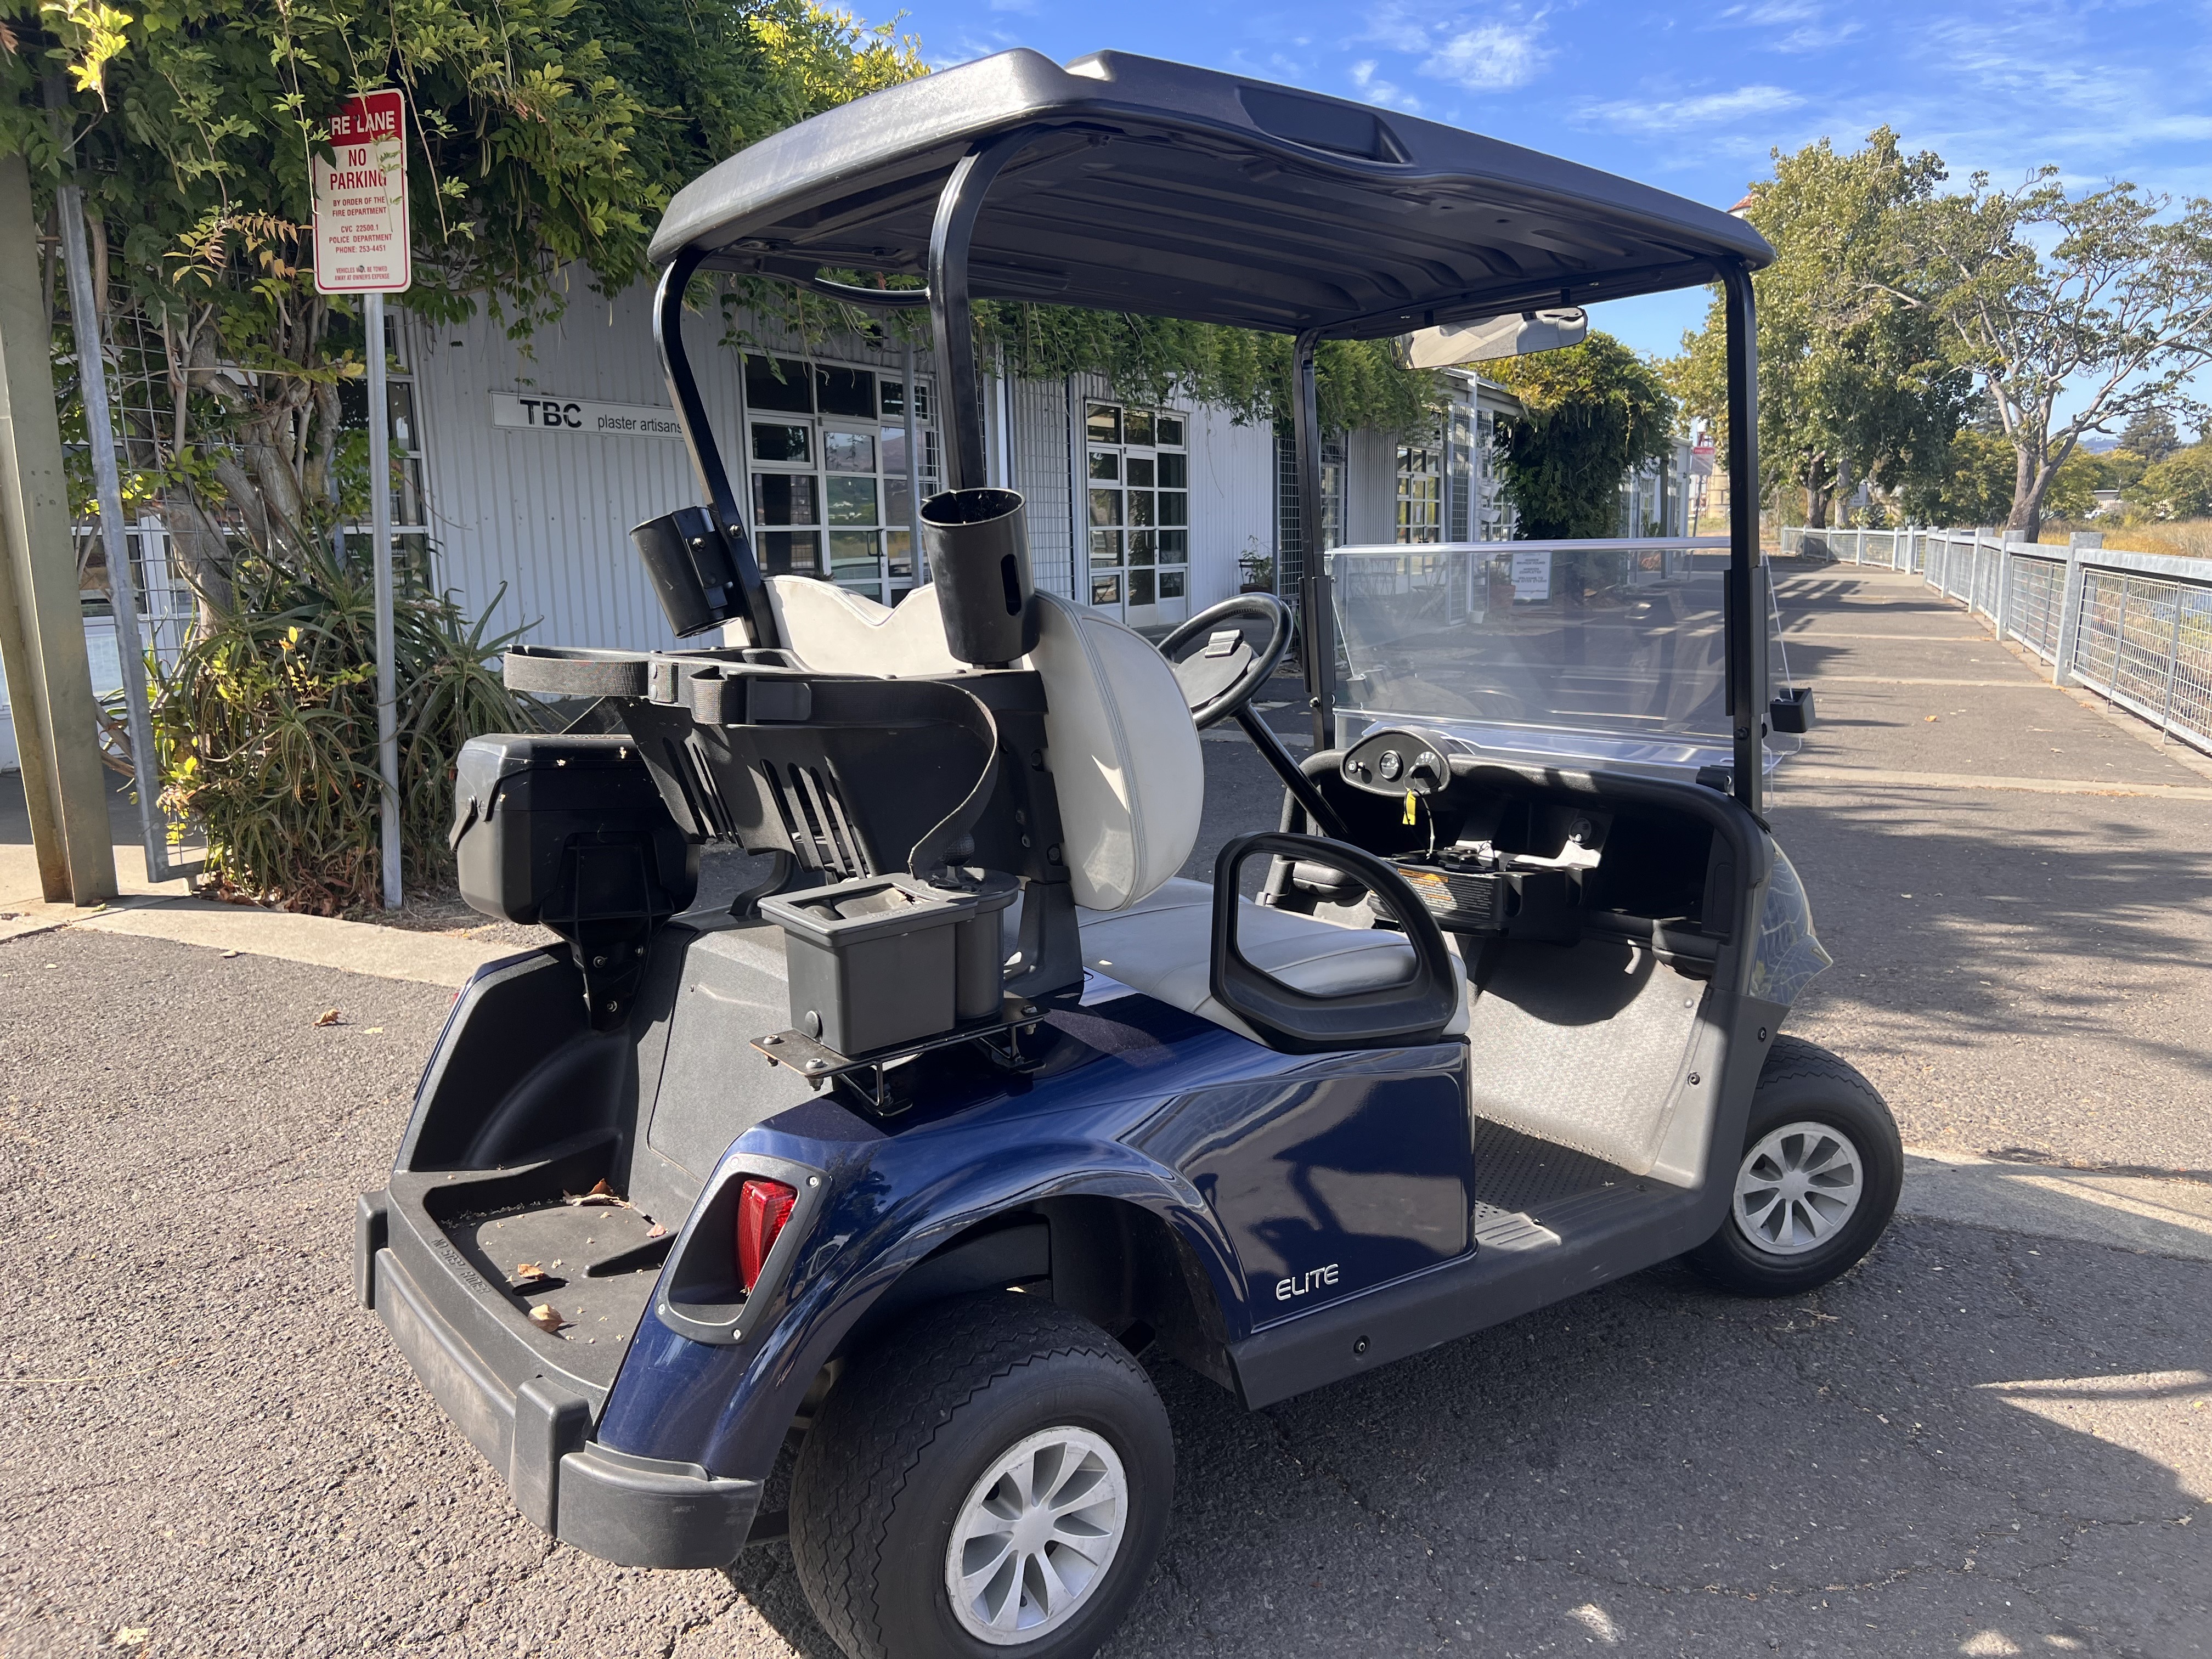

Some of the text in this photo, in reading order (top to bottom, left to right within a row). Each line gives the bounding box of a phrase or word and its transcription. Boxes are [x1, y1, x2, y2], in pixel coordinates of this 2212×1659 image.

[328, 111, 395, 136] RE LANE
[348, 148, 366, 167] NO
[330, 169, 387, 190] PARKING
[347, 207, 387, 216] DEPARTMENT
[353, 234, 392, 242] DEPARTMENT
[359, 245, 386, 253] 253-4451
[520, 399, 682, 433] TBC plaster artisans
[431, 1238, 449, 1249] NO
[441, 1250, 466, 1266] STEP
[460, 1271, 492, 1295] RIDER
[1276, 1263, 1339, 1301] ELITE
